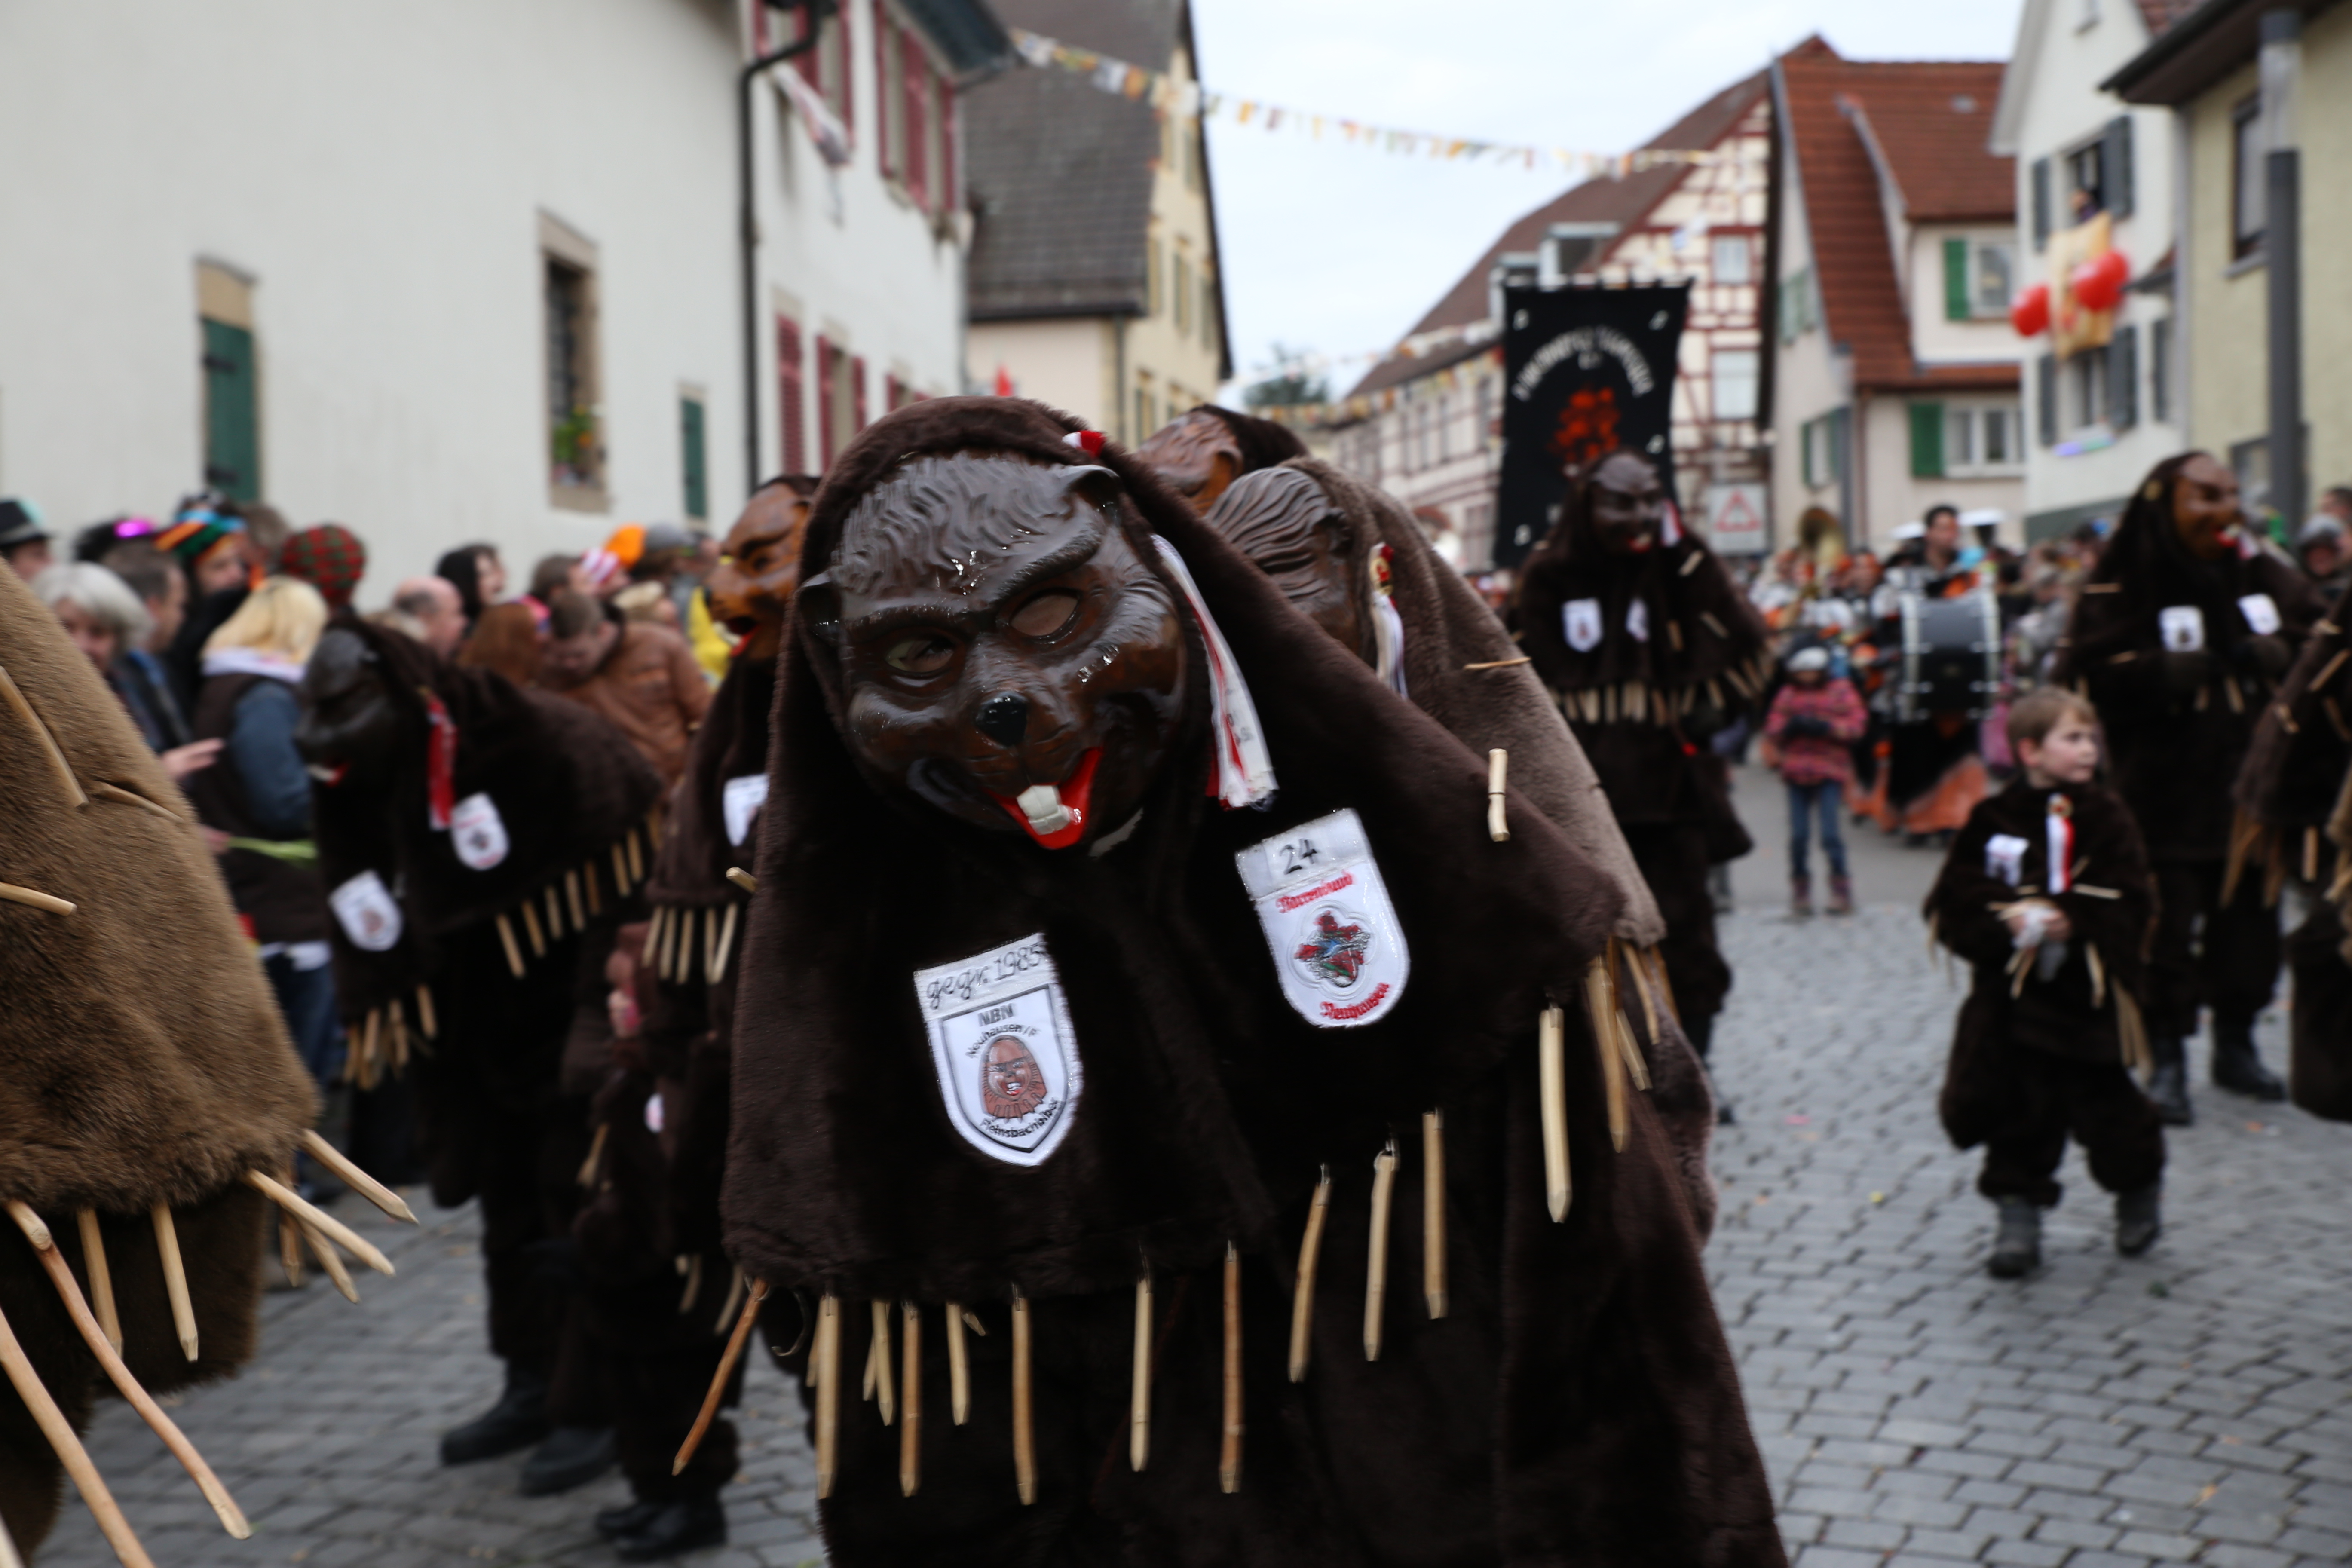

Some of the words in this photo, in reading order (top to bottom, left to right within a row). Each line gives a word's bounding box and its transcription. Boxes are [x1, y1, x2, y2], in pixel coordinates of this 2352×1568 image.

[1280, 839, 1317, 874] 24
[926, 967, 990, 1009] gegr.
[993, 942, 1047, 980] 1985
[978, 1004, 1014, 1026] NBN
